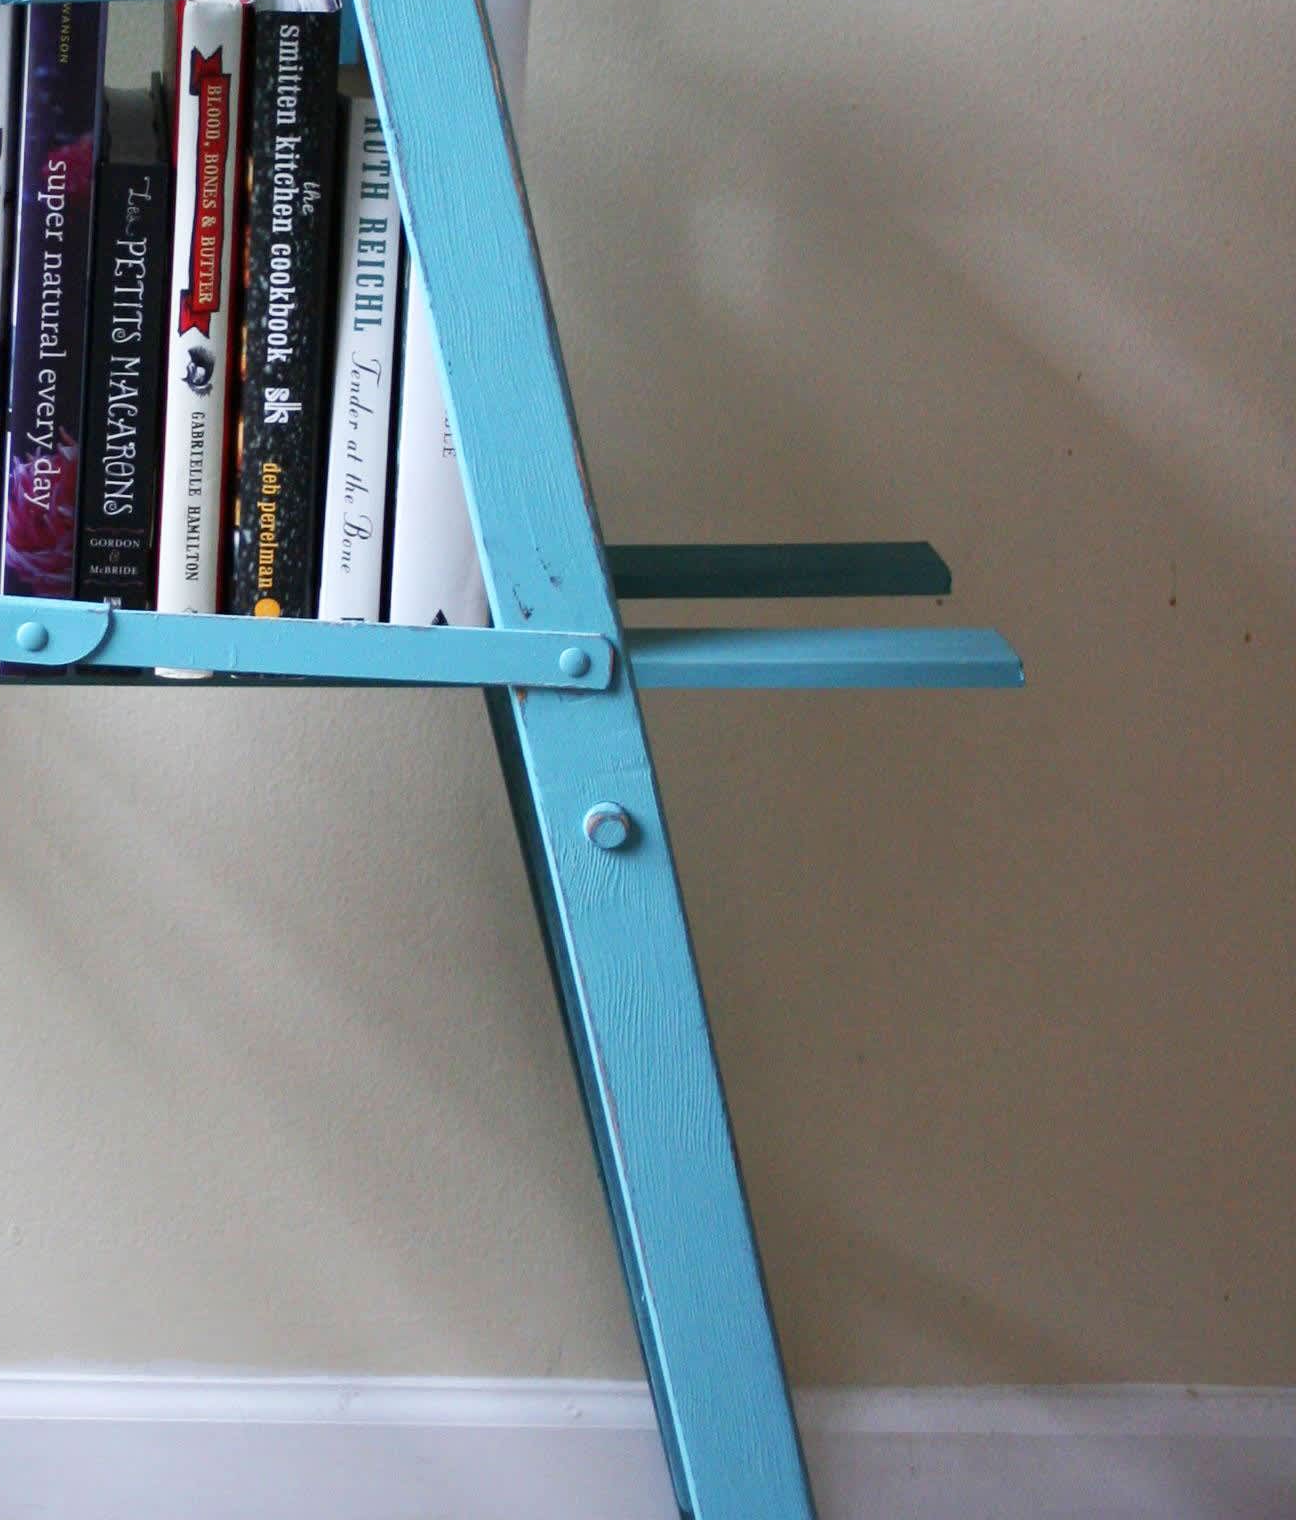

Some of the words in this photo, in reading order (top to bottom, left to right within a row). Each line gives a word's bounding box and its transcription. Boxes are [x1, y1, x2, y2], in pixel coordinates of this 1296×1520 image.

[276, 24, 303, 126] smitten
[205, 84, 222, 147] BLOOD,
[38, 159, 68, 242] super
[202, 155, 220, 209] BONES
[272, 135, 302, 233] kitchen
[302, 181, 321, 216] the
[201, 216, 216, 228] &
[39, 251, 67, 359] natural
[112, 237, 147, 344] PETITS
[198, 237, 216, 304] BUTTER
[266, 243, 296, 363] cookbook
[354, 217, 388, 332] REICHL
[28, 370, 58, 450] every
[349, 351, 382, 430] Tender
[103, 356, 141, 516] MACARONS
[189, 412, 205, 496] GABRIELLE
[346, 440, 364, 463] at
[24, 457, 61, 511] day
[261, 462, 282, 495] deb
[344, 473, 368, 504] the
[90, 537, 140, 548] GORDON
[184, 505, 202, 581] HAMILTON
[256, 501, 282, 589] perelman
[340, 512, 374, 574] Bone
